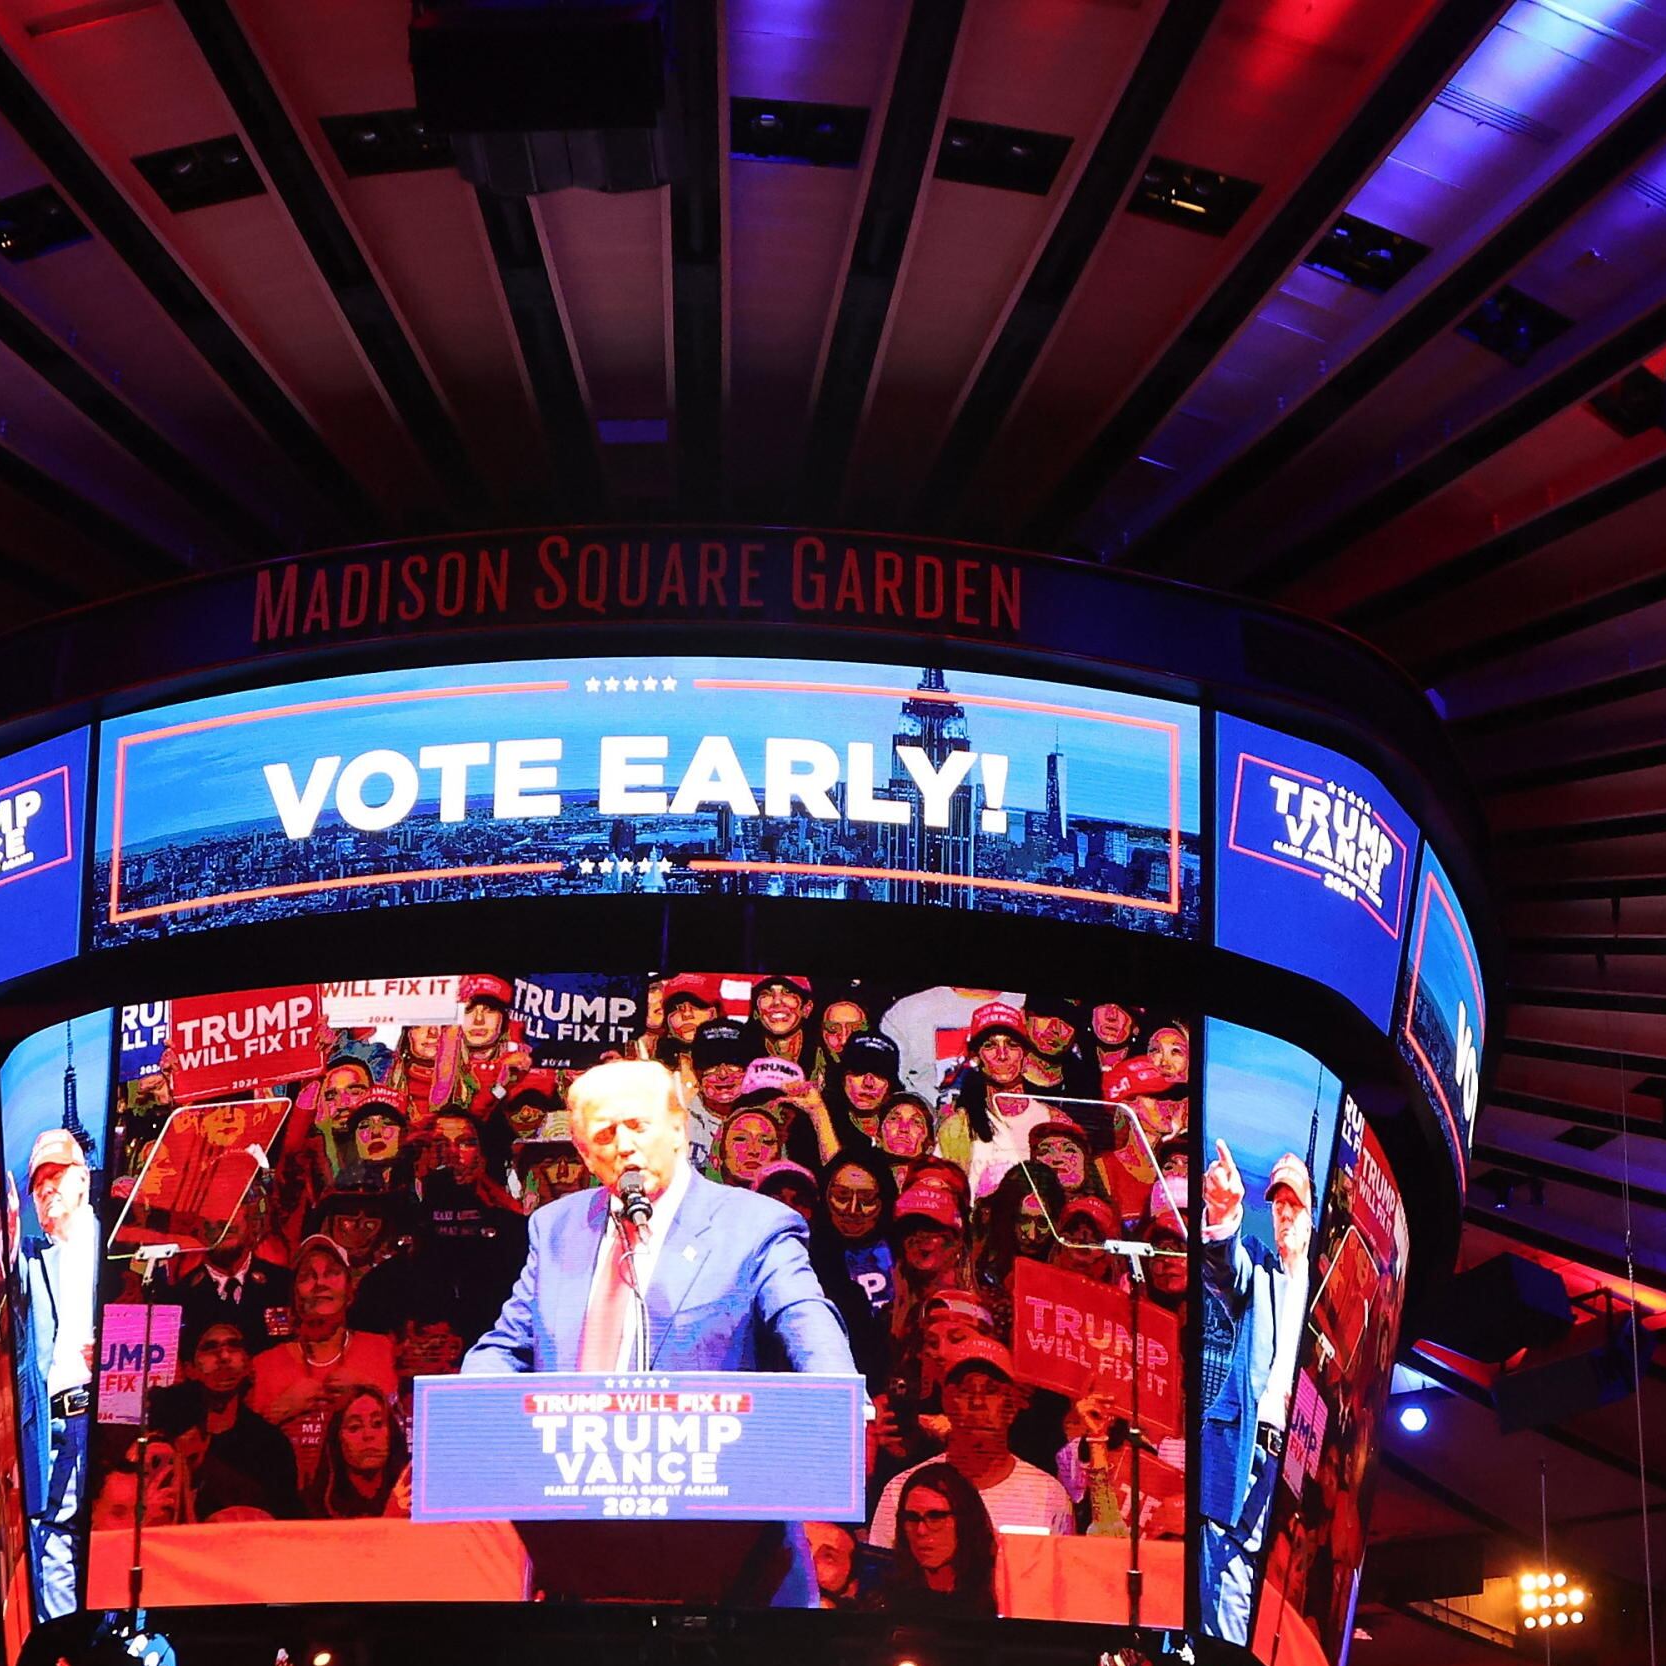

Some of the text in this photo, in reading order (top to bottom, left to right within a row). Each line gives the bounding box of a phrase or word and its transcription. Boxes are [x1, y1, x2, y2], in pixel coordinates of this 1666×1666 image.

[252, 536, 1021, 643] MADISON SQUARE GARDEN
[262, 735, 1010, 841] VOTE EARLY!
[1269, 775, 1393, 866] TRUMP
[1285, 814, 1383, 895] VANCE
[320, 978, 450, 999] WILL FIX IT
[514, 978, 637, 1024] TRUMP
[176, 996, 313, 1050] TRUMP
[557, 1022, 601, 1042] FIX
[608, 1025, 635, 1044] IT
[178, 1026, 313, 1071] WILL FIX IT
[1362, 1147, 1396, 1217] TRUMP
[1025, 1295, 1169, 1371] TRUMP
[105, 1374, 137, 1393] FIX
[1027, 1329, 1092, 1370] WILL
[1147, 1372, 1169, 1397] IT
[532, 1393, 612, 1413] TRUMP
[616, 1394, 674, 1412] WILL
[678, 1394, 716, 1412] FIX
[532, 1414, 742, 1453] TRUMP
[554, 1451, 718, 1484] VANCE
[544, 1485, 580, 1497] MAKE
[582, 1485, 638, 1497] AMERICA
[602, 1497, 669, 1517] 2024
